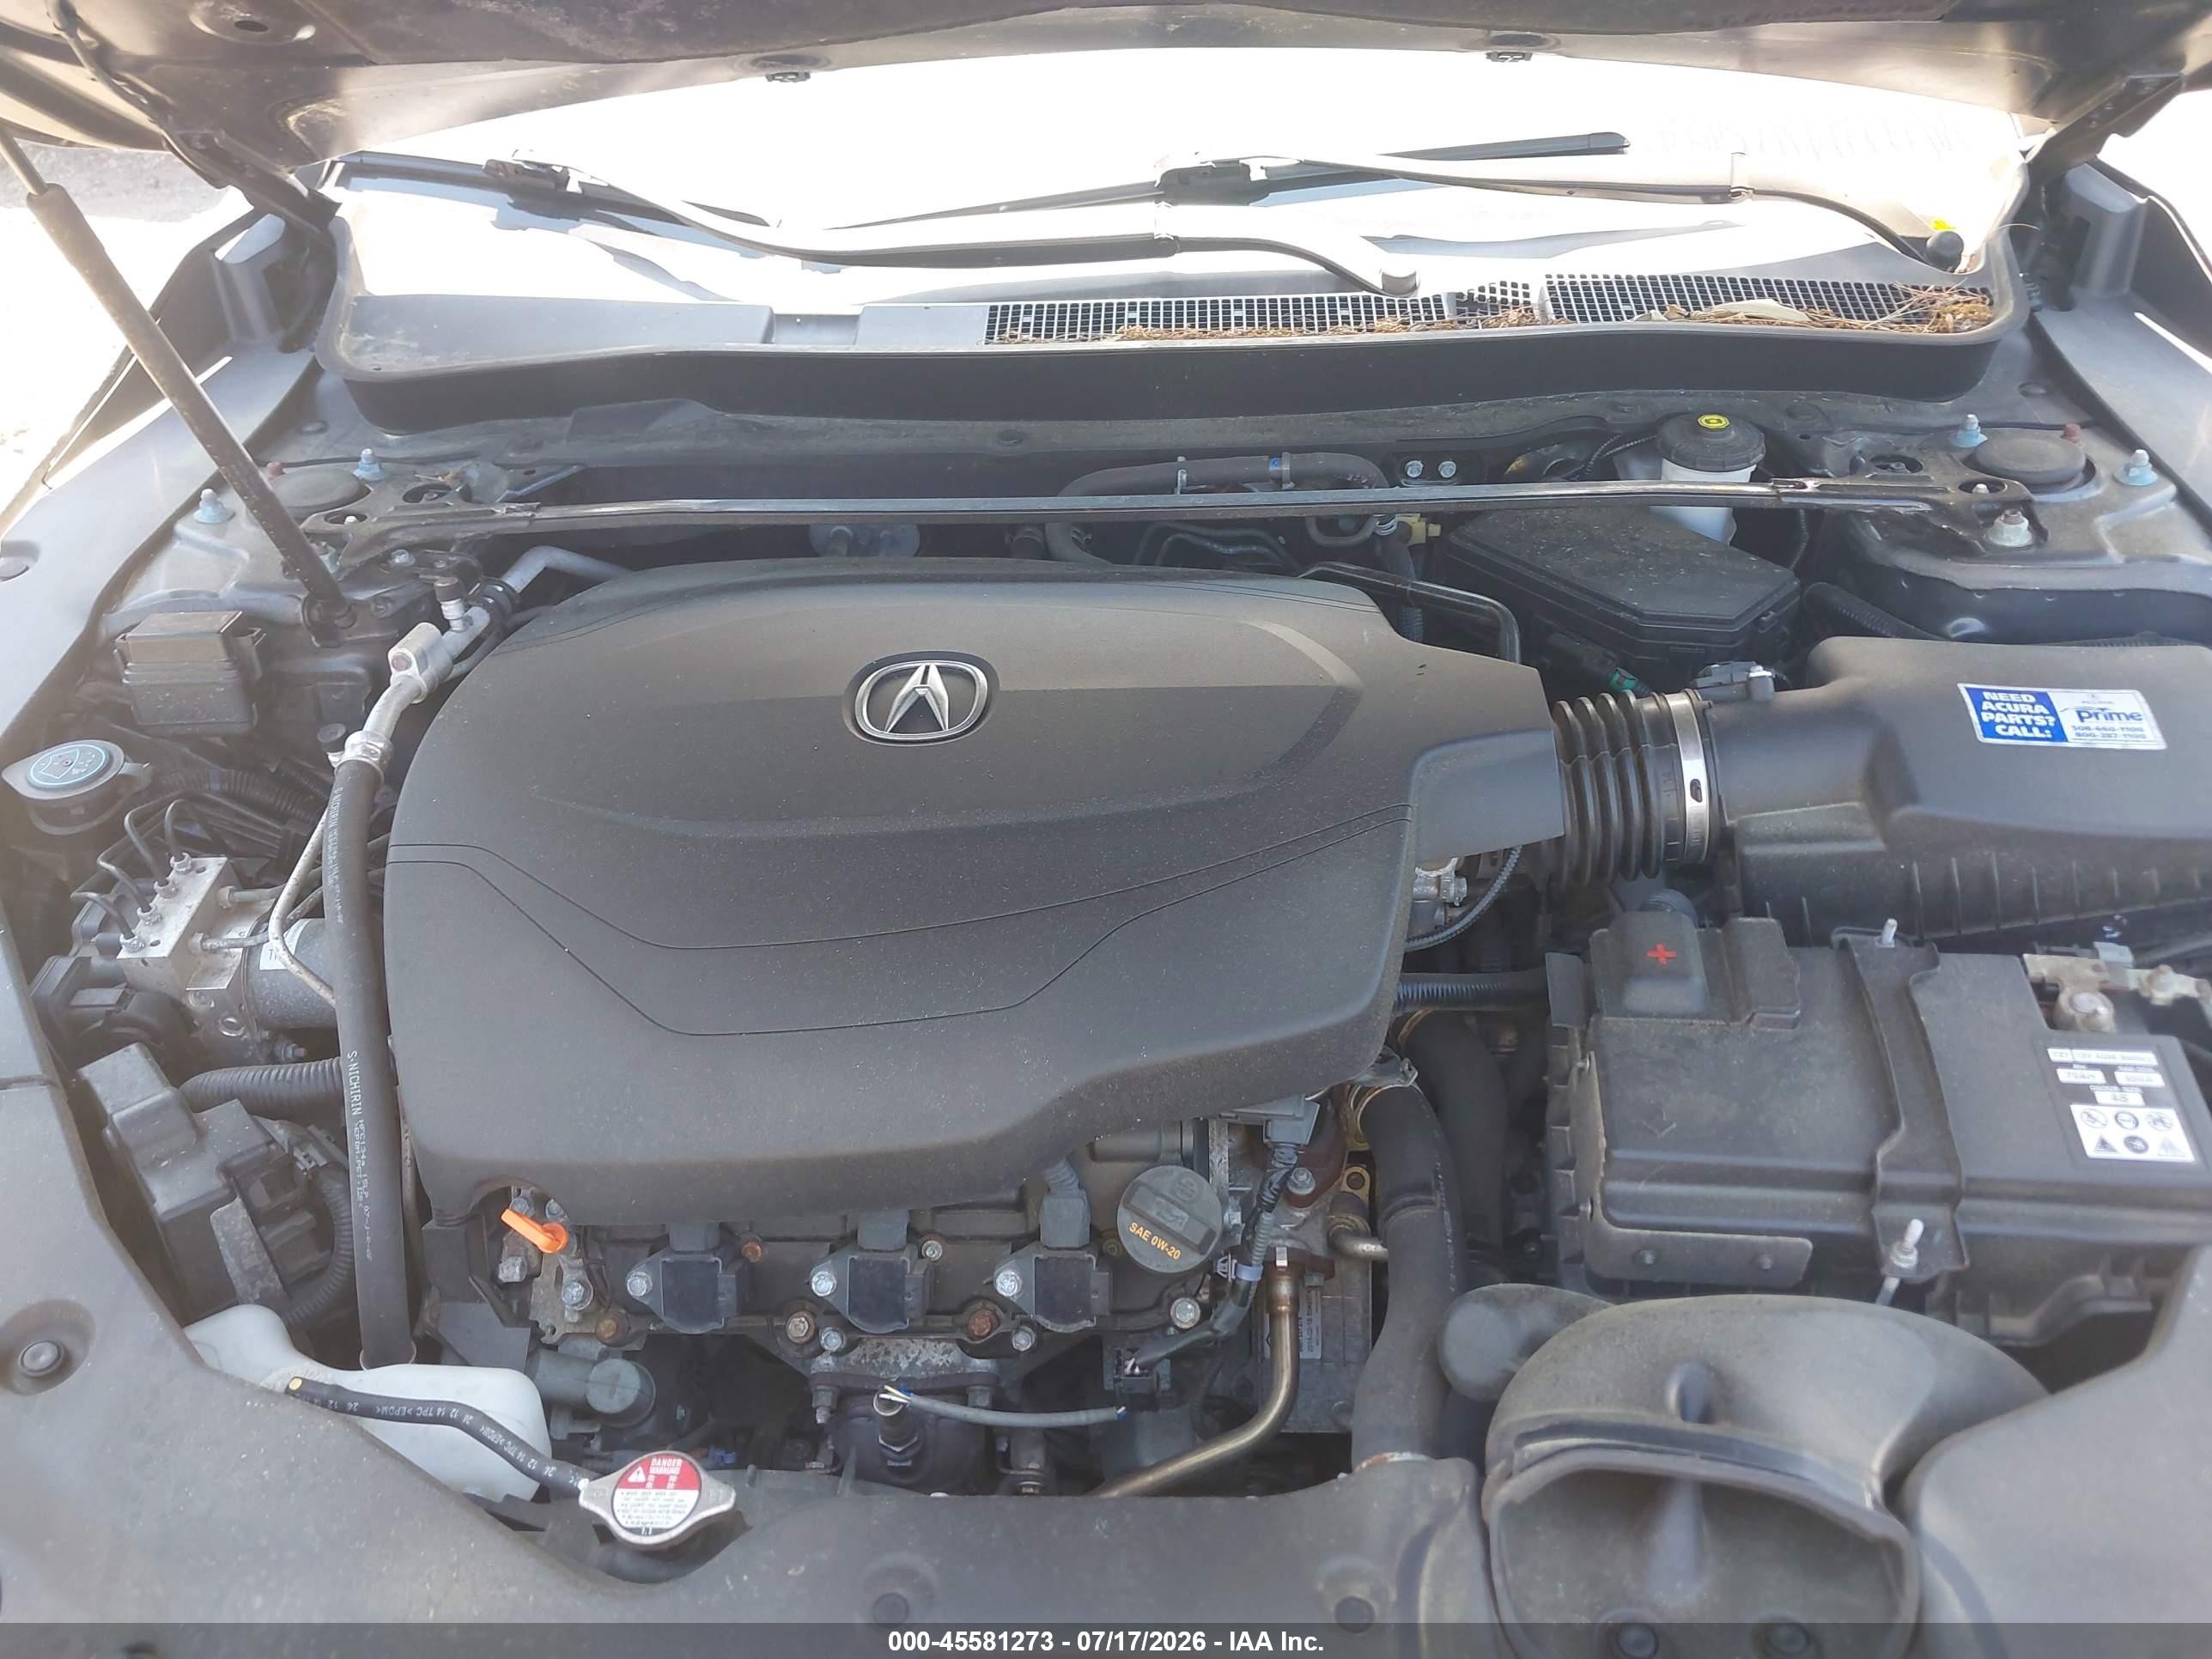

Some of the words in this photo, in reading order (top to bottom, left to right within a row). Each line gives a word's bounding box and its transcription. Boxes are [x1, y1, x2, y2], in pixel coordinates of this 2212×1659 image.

[1982, 691, 2036, 702] NEED
[1982, 701, 2050, 714] ACURA
[1981, 712, 2056, 726] PARTS?
[2075, 710, 2143, 722] prime
[1995, 725, 2052, 738] CALL:
[1129, 1222, 1152, 1241] SAE
[1151, 1236, 1182, 1260] 0W-20
[416, 1407, 433, 1417] TPC
[651, 1458, 683, 1467] DANGER
